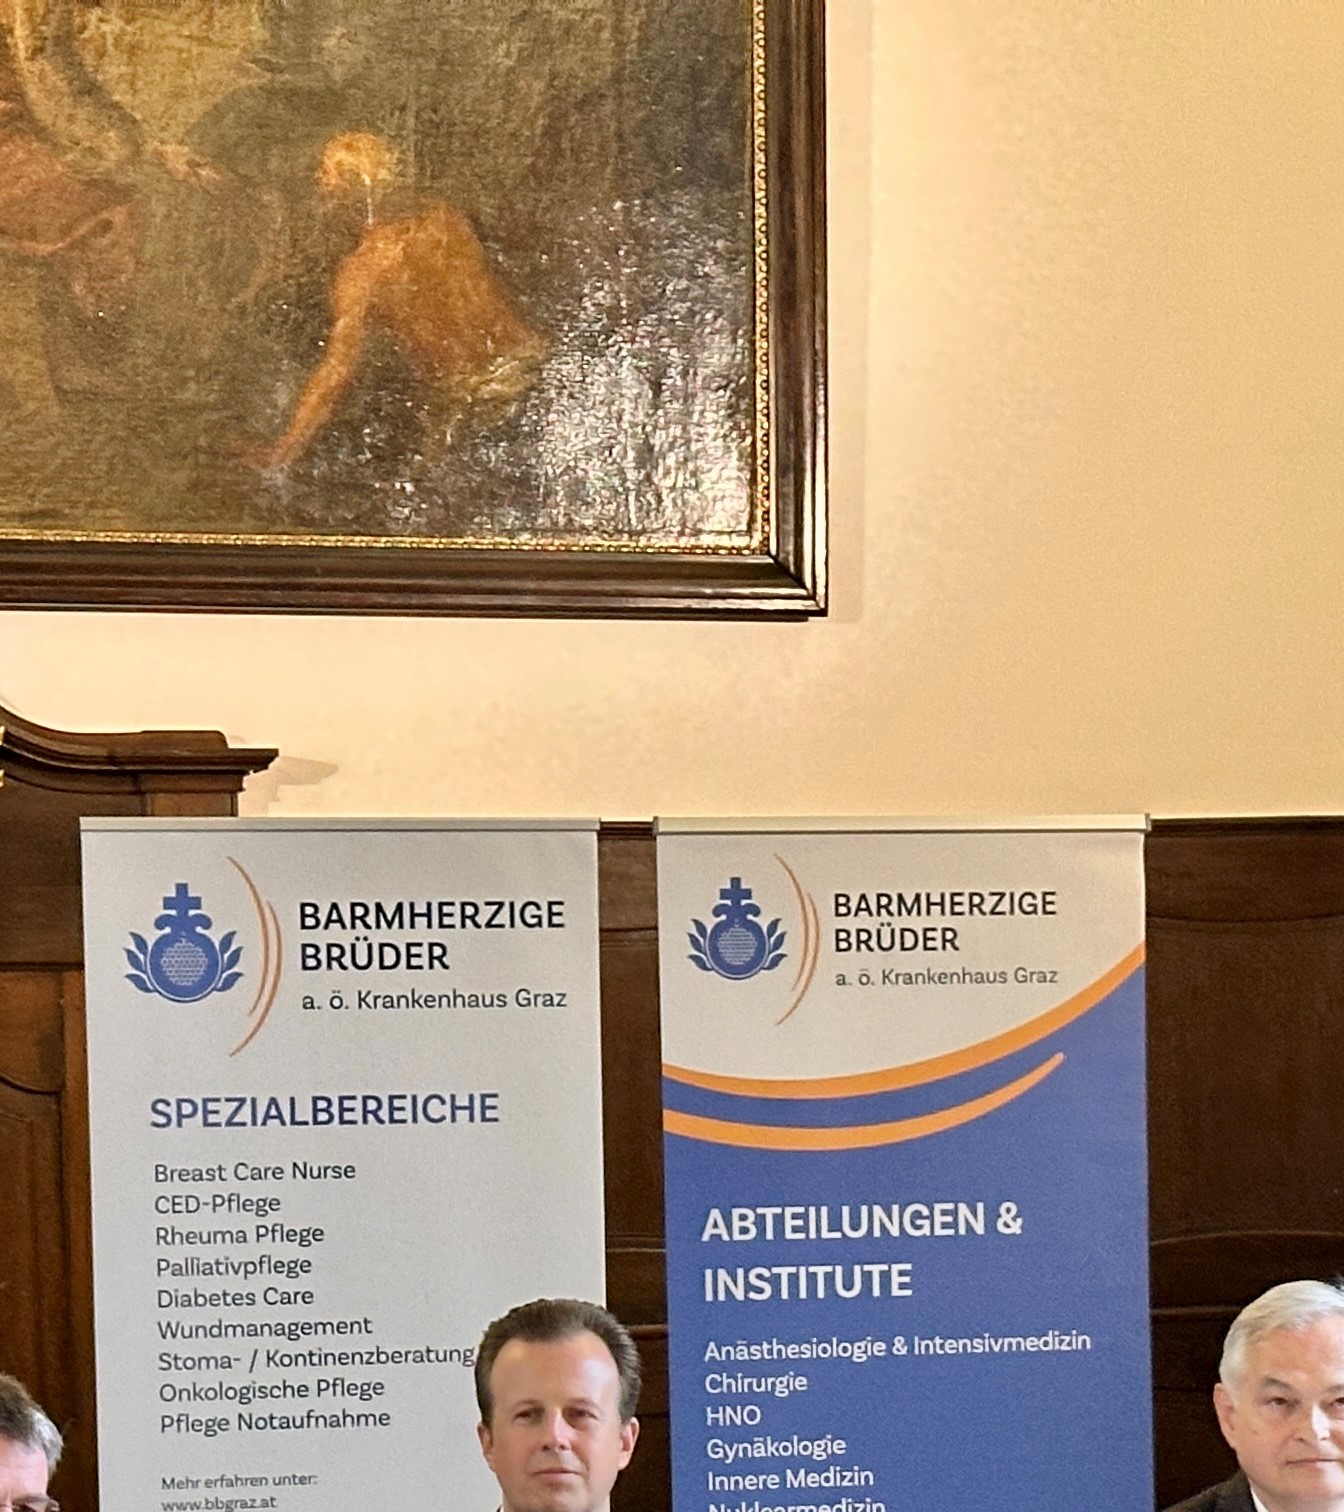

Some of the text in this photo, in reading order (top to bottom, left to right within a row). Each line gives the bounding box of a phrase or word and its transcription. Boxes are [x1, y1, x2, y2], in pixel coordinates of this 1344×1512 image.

[300, 901, 564, 930] BARMHERZIGE
[835, 892, 1056, 917] BARMHERZIGE
[835, 922, 959, 952] BRÜDER
[301, 936, 449, 971] BRÜDER
[836, 967, 1058, 986] a. ö. Krankenhaus Graz
[303, 988, 567, 1009] a. ö. Krankenhaus Graz
[151, 1093, 499, 1128] SPEZIALBEREICHE
[155, 1162, 355, 1182] Breast Care Nurse
[155, 1193, 280, 1217] CED-Pflege
[702, 1202, 1022, 1241] ABTEILUNGEN &
[156, 1223, 324, 1247] Rheuma Pflege
[157, 1255, 312, 1280] Palliativpflege
[705, 1264, 912, 1301] INSTITUTE
[158, 1287, 313, 1308] Diabetes Care
[158, 1318, 373, 1341] Wundmanagement
[159, 1344, 476, 1373] Stoma- / Kontinenzberatung
[705, 1330, 1091, 1362] Anästhesiologie & Intensivmedizin
[160, 1378, 384, 1405] Onkologische Pflege
[706, 1371, 807, 1397] Chirurgie
[162, 1408, 390, 1437] Pflege Notaufnahme
[707, 1405, 761, 1426] HNO
[707, 1435, 846, 1463] Gynäkologie
[162, 1477, 200, 1489] Mehr
[205, 1474, 268, 1488] erfahren
[709, 1466, 873, 1490] Innere Medizin
[161, 1497, 277, 1512] www.bbgraz.at
